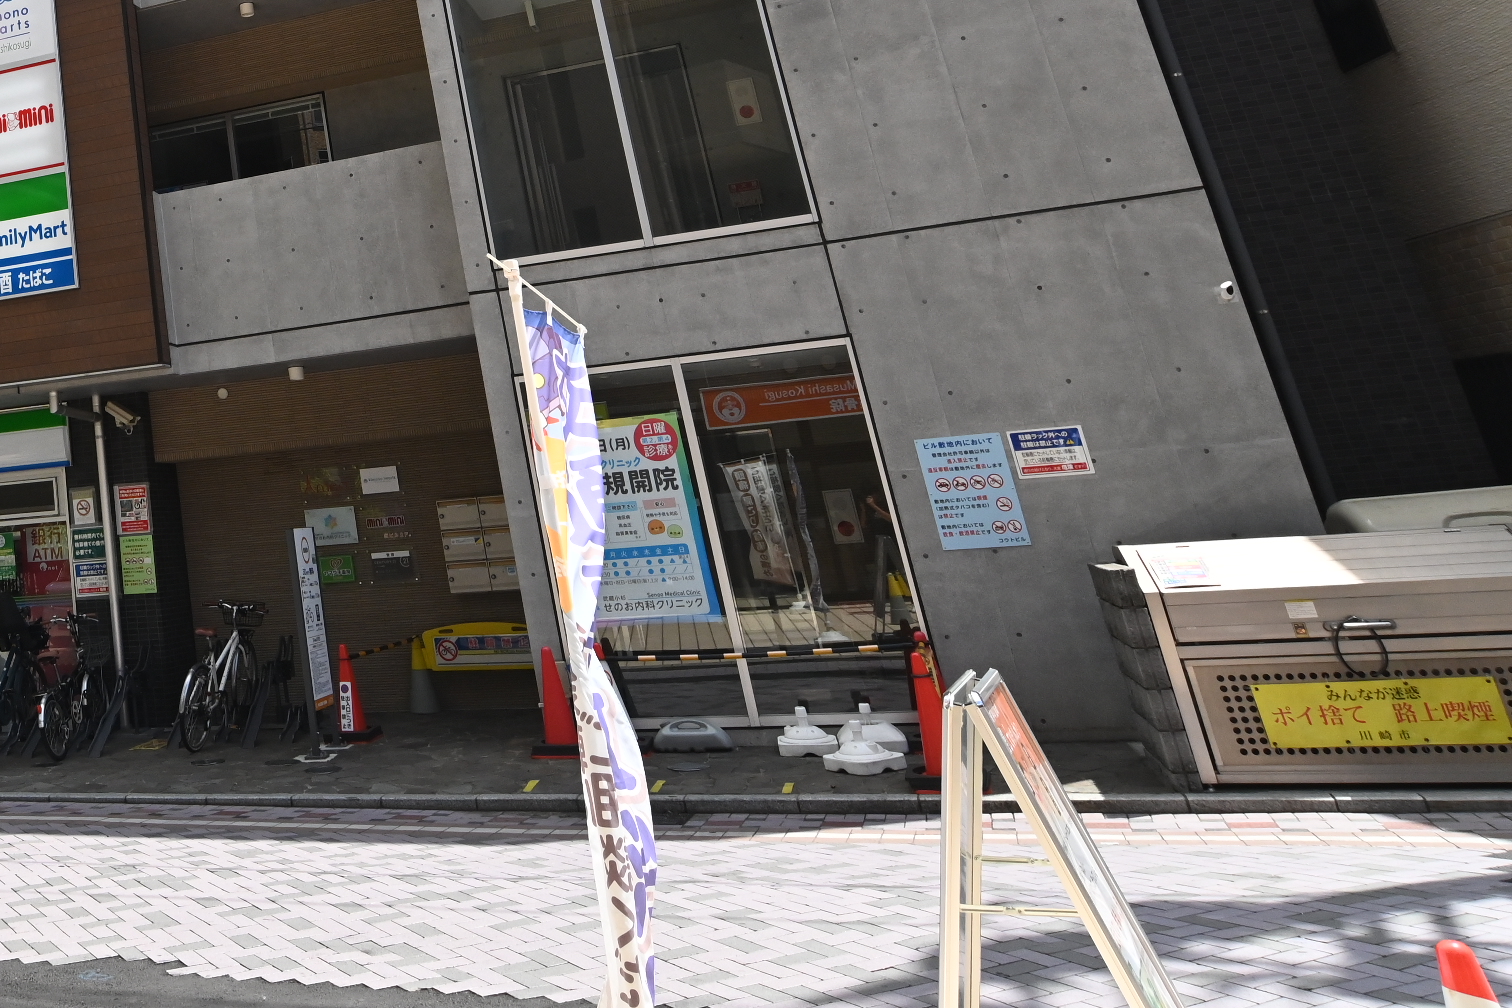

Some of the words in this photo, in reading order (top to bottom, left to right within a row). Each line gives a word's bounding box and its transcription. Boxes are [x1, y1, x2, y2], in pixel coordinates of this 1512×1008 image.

[18, 103, 55, 130] mini
[18, 267, 54, 290] たばこ
[641, 421, 666, 435] 日曜
[922, 437, 993, 450] ビル敷地内において
[601, 456, 641, 469] クリニック
[603, 466, 679, 495] 規開院
[31, 527, 61, 546] 銀行
[32, 547, 64, 561] ATM
[604, 597, 703, 613] せのお内科クリニック
[1326, 685, 1422, 702] みんなが迷惑
[1271, 705, 1367, 727] ポイ捨て
[1392, 699, 1497, 724] 路上喫煙
[1359, 729, 1411, 742] 川崎市
